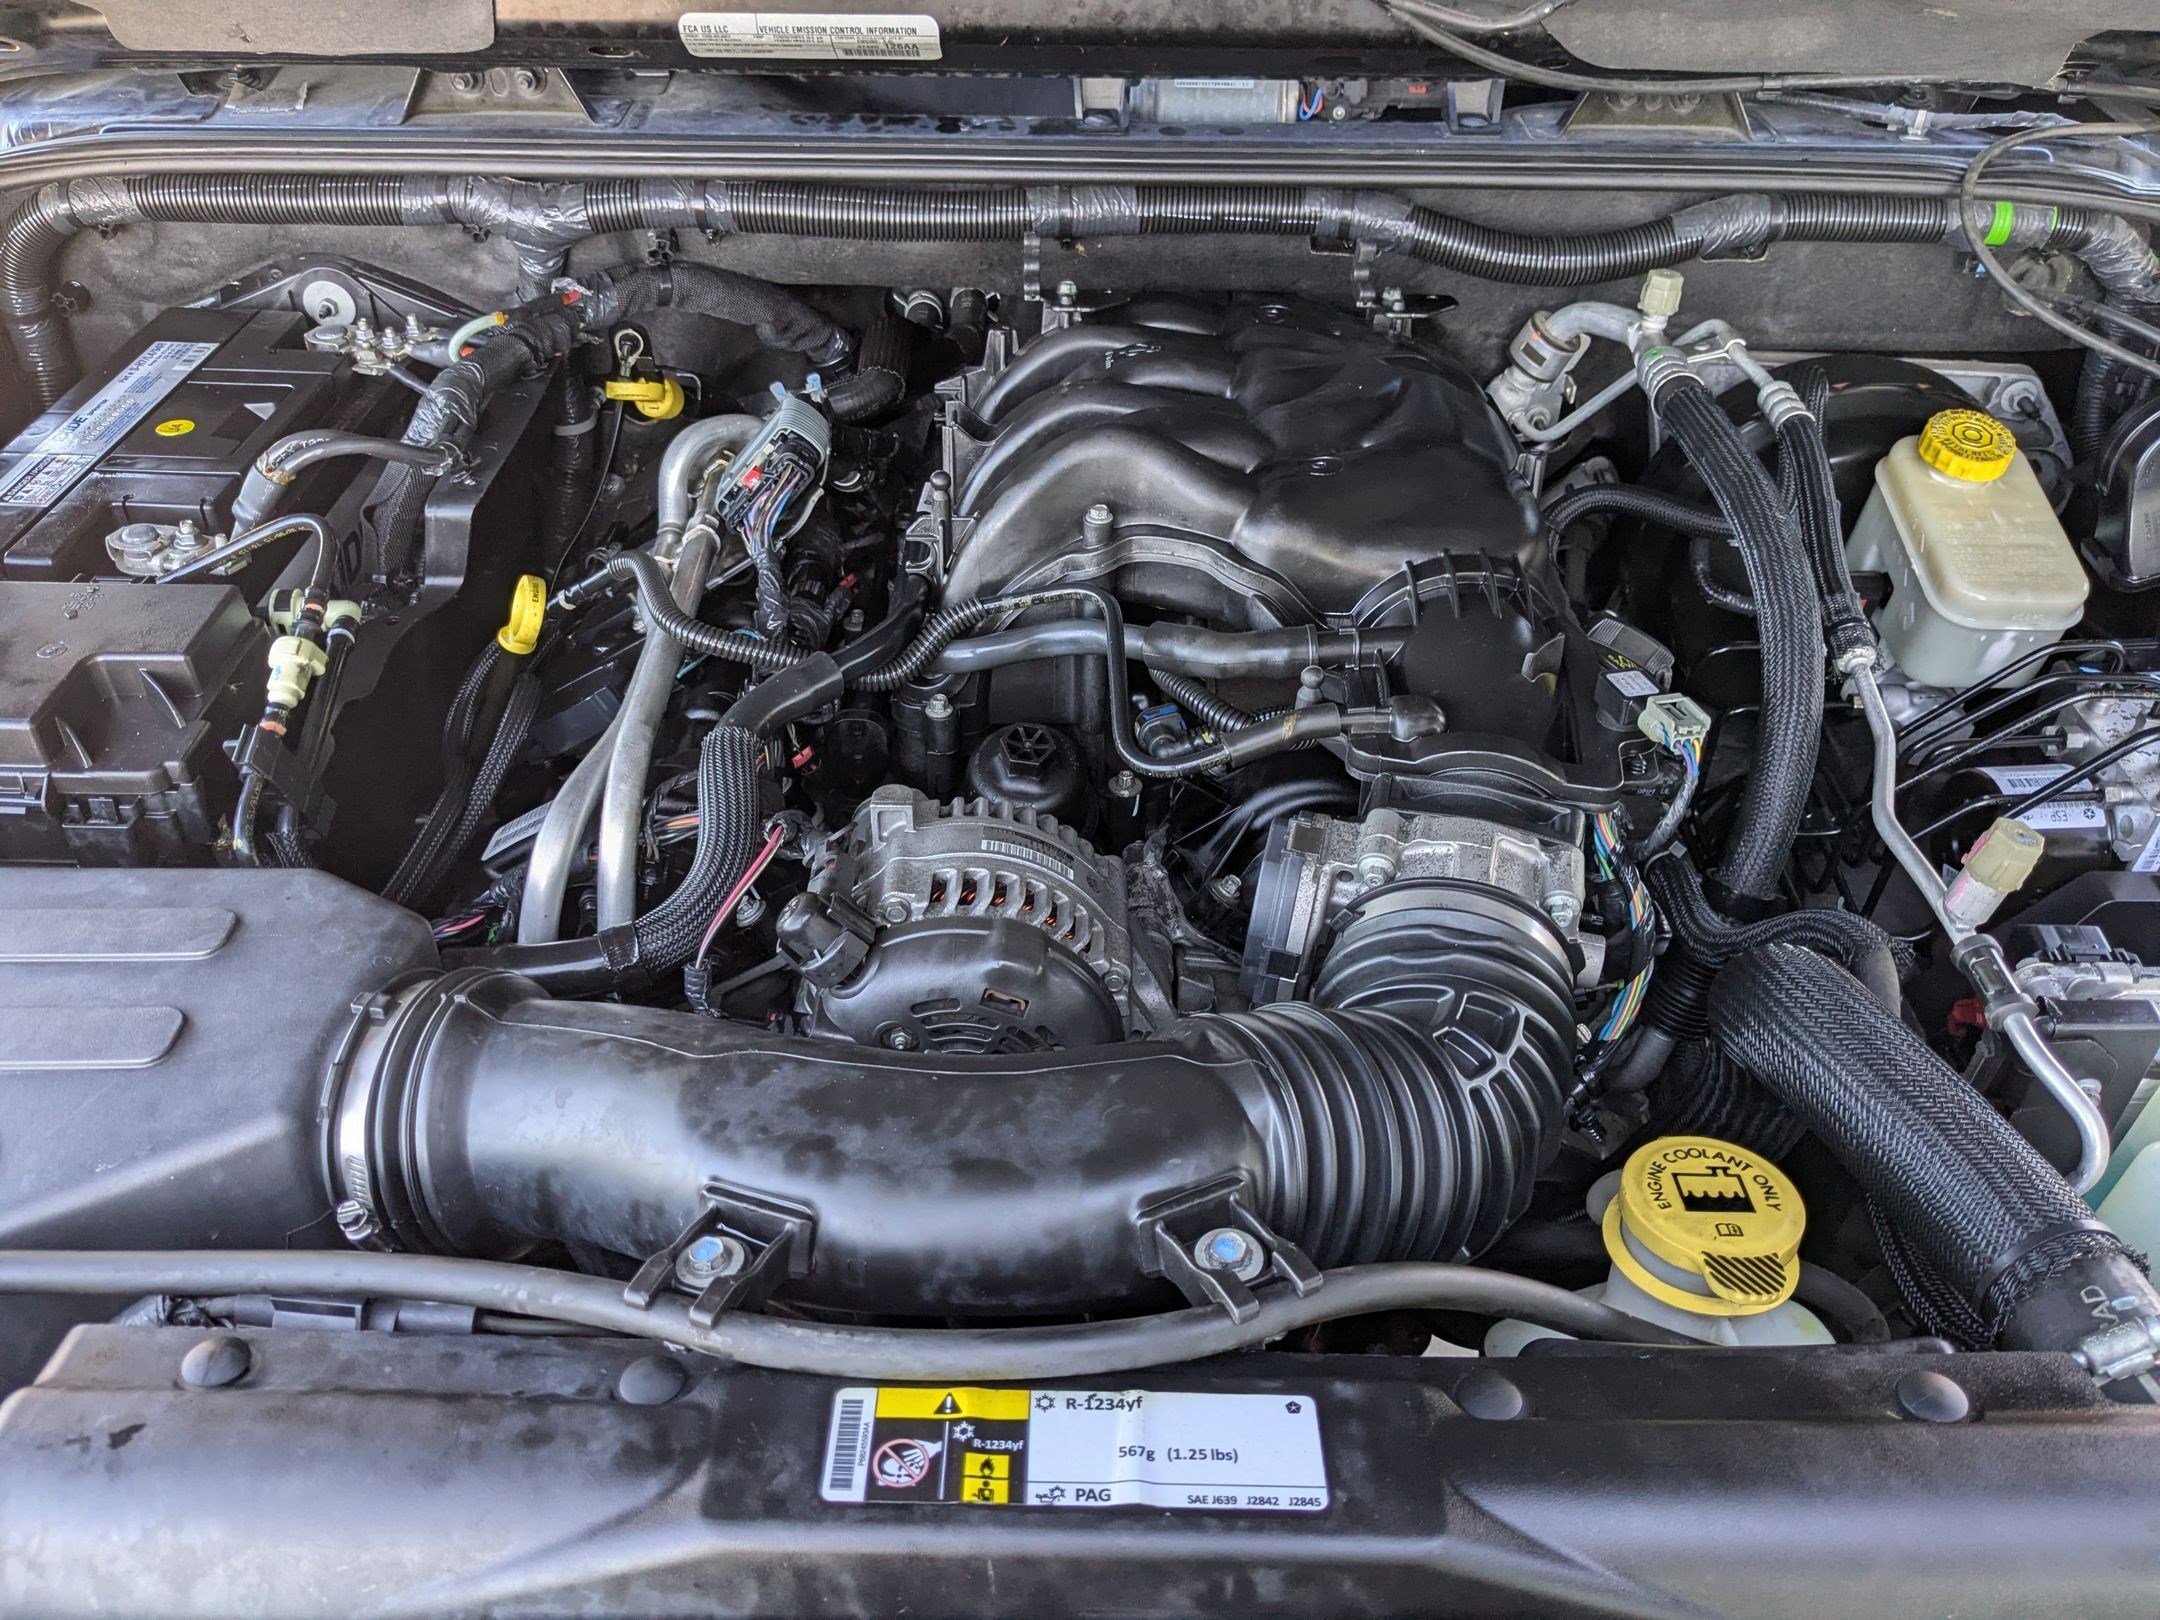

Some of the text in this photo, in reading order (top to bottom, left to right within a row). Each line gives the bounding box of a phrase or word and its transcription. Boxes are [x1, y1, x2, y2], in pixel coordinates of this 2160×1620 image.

[683, 25, 729, 34] FCA US LLC
[759, 25, 918, 36] VEHICLE EMISSION CONTROL INFORMATION
[2050, 809, 2068, 822] ESP
[1647, 1147, 1782, 1212] ENGINE COOLANT ONLY
[1066, 1395, 1143, 1412] R-1234yf
[973, 1438, 1025, 1452] R-1234yf
[1118, 1445, 1239, 1464] 567g (1.25 lbs)
[1075, 1488, 1111, 1502] PAG
[1187, 1494, 1322, 1507] SAE J639 J2842 J2845
